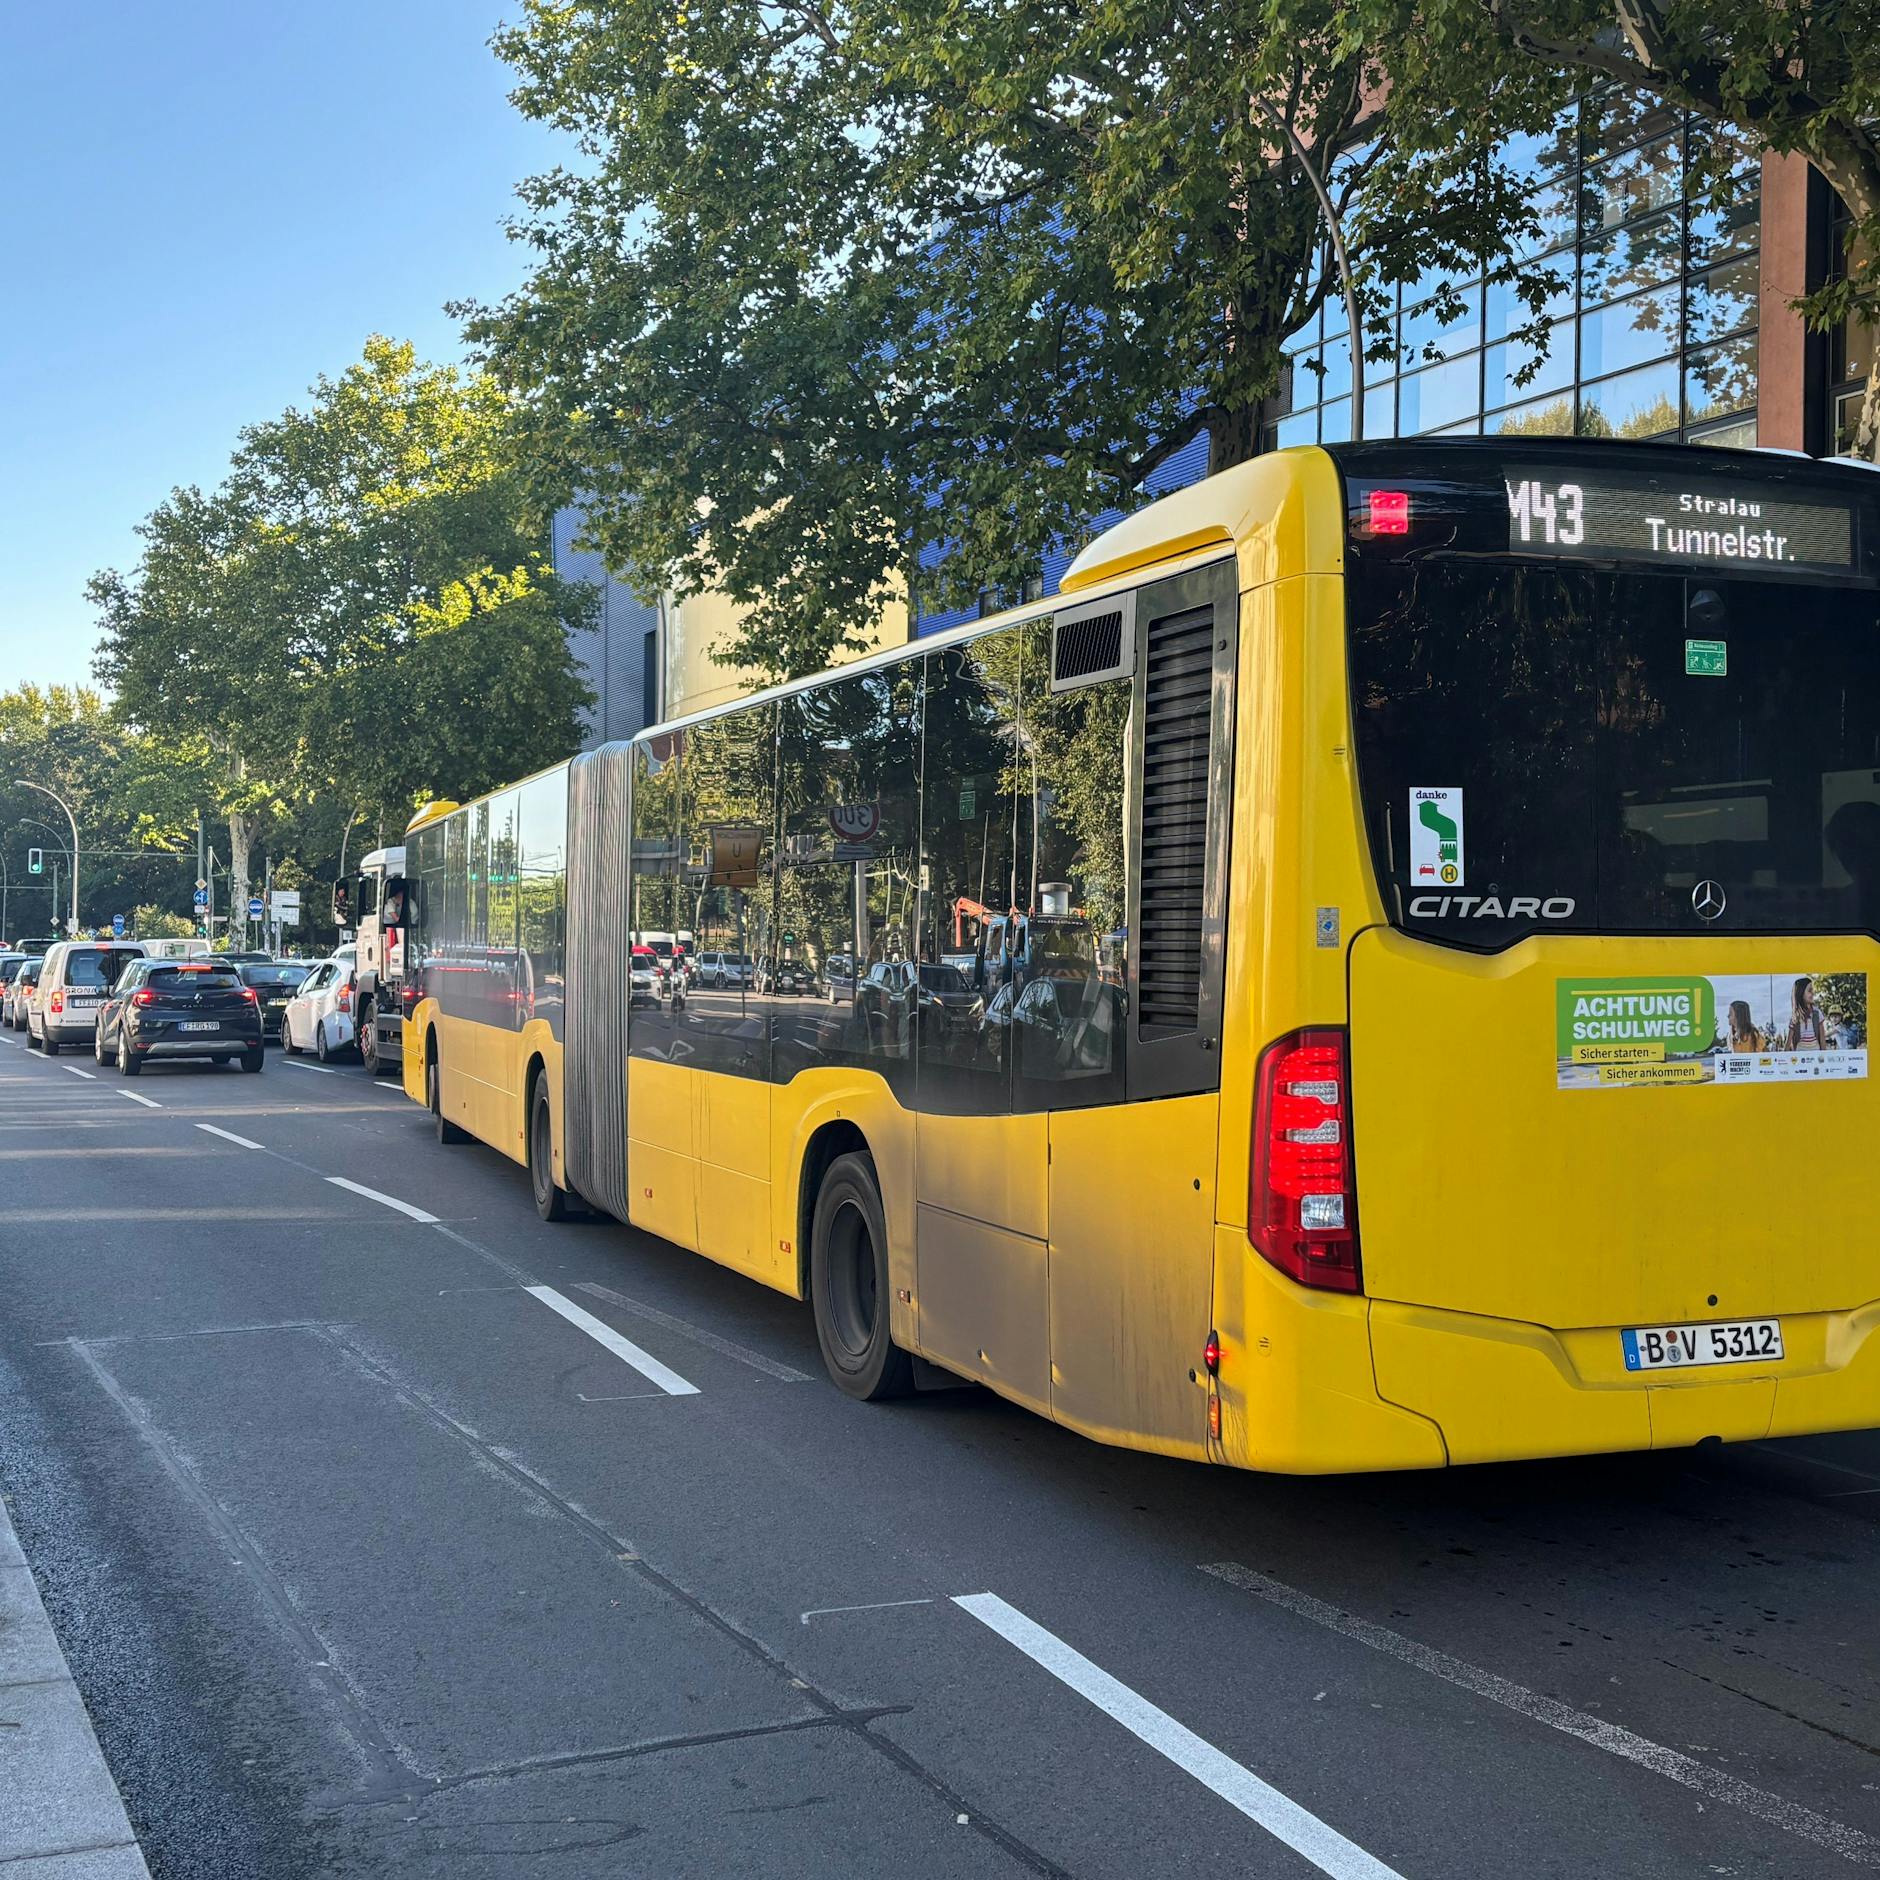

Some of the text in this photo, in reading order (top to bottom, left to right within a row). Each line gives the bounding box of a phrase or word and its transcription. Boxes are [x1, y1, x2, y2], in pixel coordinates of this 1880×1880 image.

[1679, 494, 1761, 518] Stralau
[1645, 518, 1796, 562] Tunnelstr.
[1416, 790, 1448, 800] danke
[1408, 895, 1577, 919] CITARO
[1573, 995, 1690, 1018] ACHTUNG
[1573, 1019, 1690, 1040] SCHULWEG
[1580, 1048, 1612, 1060] Sicher
[1613, 1047, 1649, 1059] starten
[1606, 1066, 1695, 1080] Sicher ankommen
[1645, 1332, 1665, 1363] B
[1680, 1329, 1697, 1361] V
[1710, 1325, 1776, 1358] 5312
